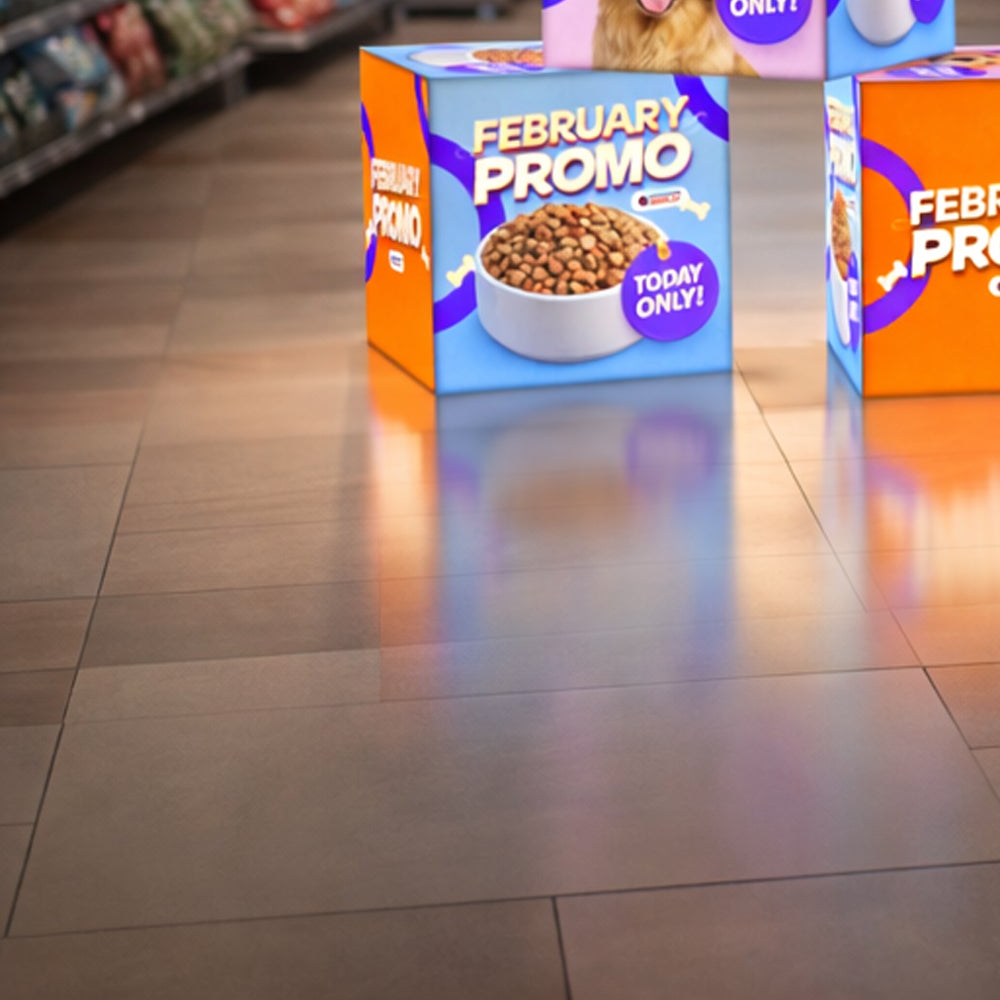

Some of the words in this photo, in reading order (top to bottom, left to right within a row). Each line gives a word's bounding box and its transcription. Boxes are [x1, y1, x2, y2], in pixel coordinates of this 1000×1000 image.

[473, 95, 689, 155] FEBRUARY
[473, 132, 692, 207] PROMO
[634, 262, 704, 294] TODAY
[635, 285, 705, 319] ONLY!
